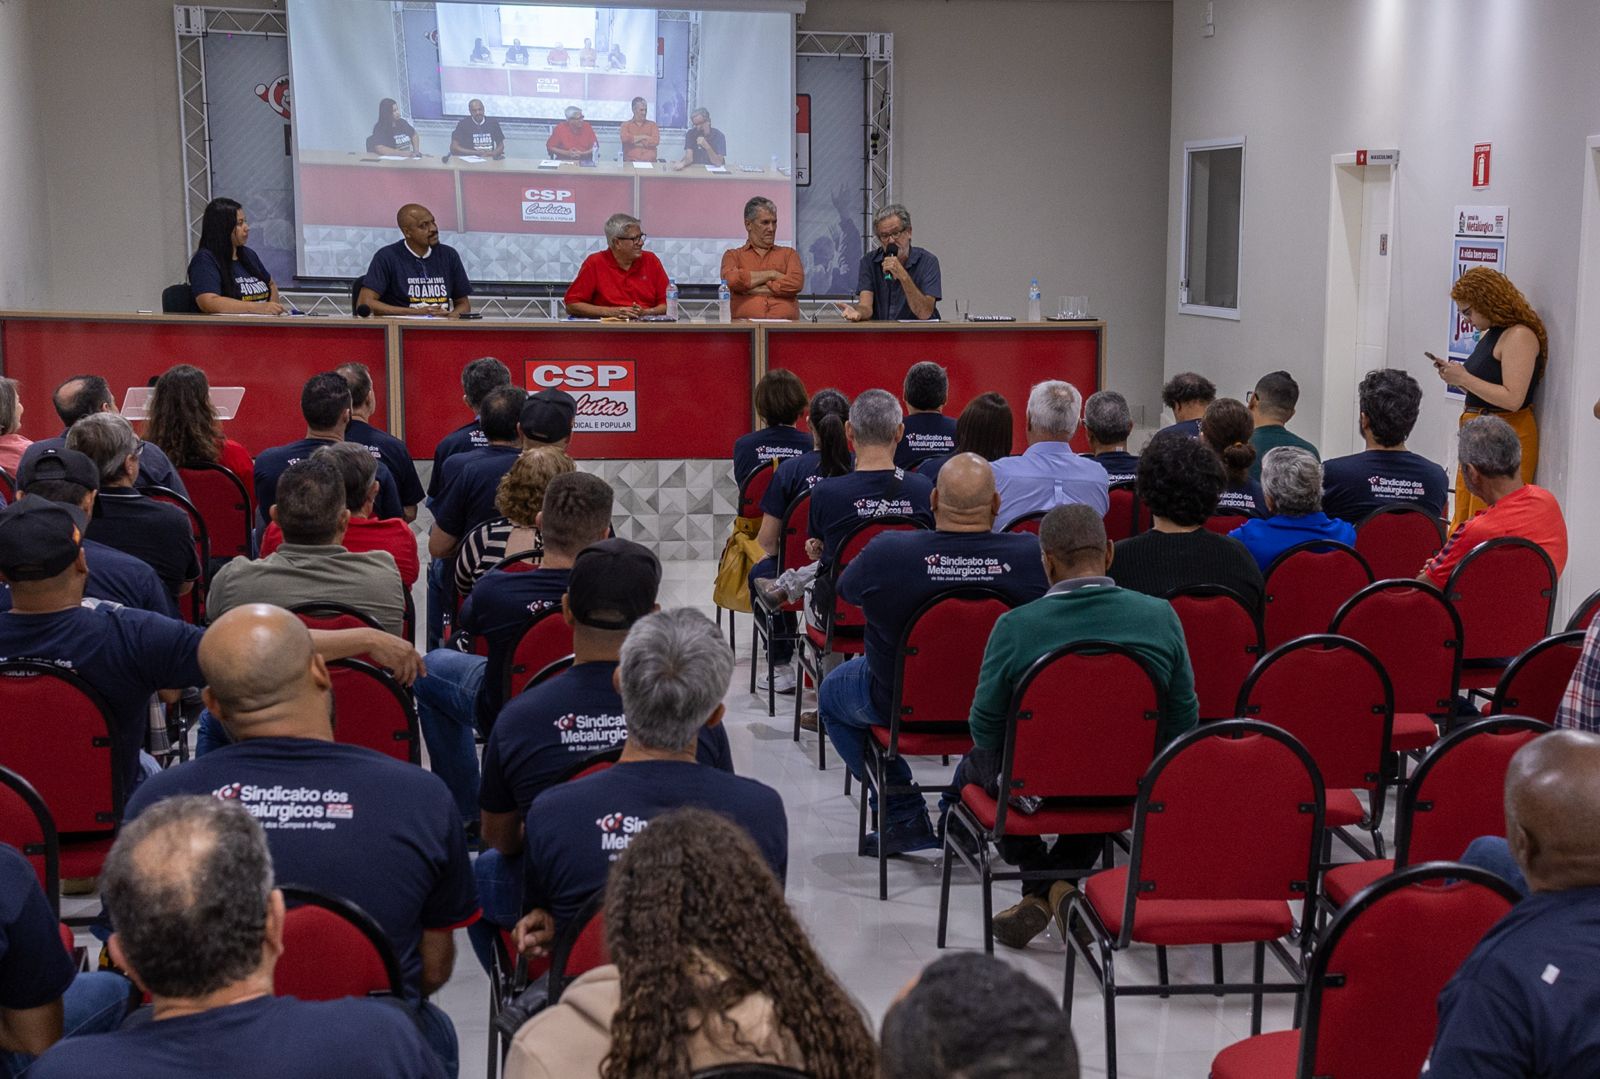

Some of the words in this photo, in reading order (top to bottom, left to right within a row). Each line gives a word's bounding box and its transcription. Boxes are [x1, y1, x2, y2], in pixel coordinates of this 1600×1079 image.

[525, 190, 572, 200] CSP
[1466, 221, 1493, 234] Metalúrgico
[408, 285, 420, 298] 40
[422, 284, 447, 297] ANOS
[533, 365, 628, 387] CSP
[576, 393, 628, 416] lutas
[1380, 478, 1411, 487] Sindicato
[1372, 485, 1413, 496] Metalúrgicos
[940, 556, 983, 566] Sindicato
[928, 565, 986, 577] Metalúrgicos
[576, 714, 627, 728] Sindicat
[561, 727, 628, 744] Metalúrgic
[576, 743, 587, 751] São
[240, 785, 320, 801] Sindicato
[322, 789, 348, 803] dos
[278, 821, 305, 829] Campos
[312, 821, 336, 830] Região
